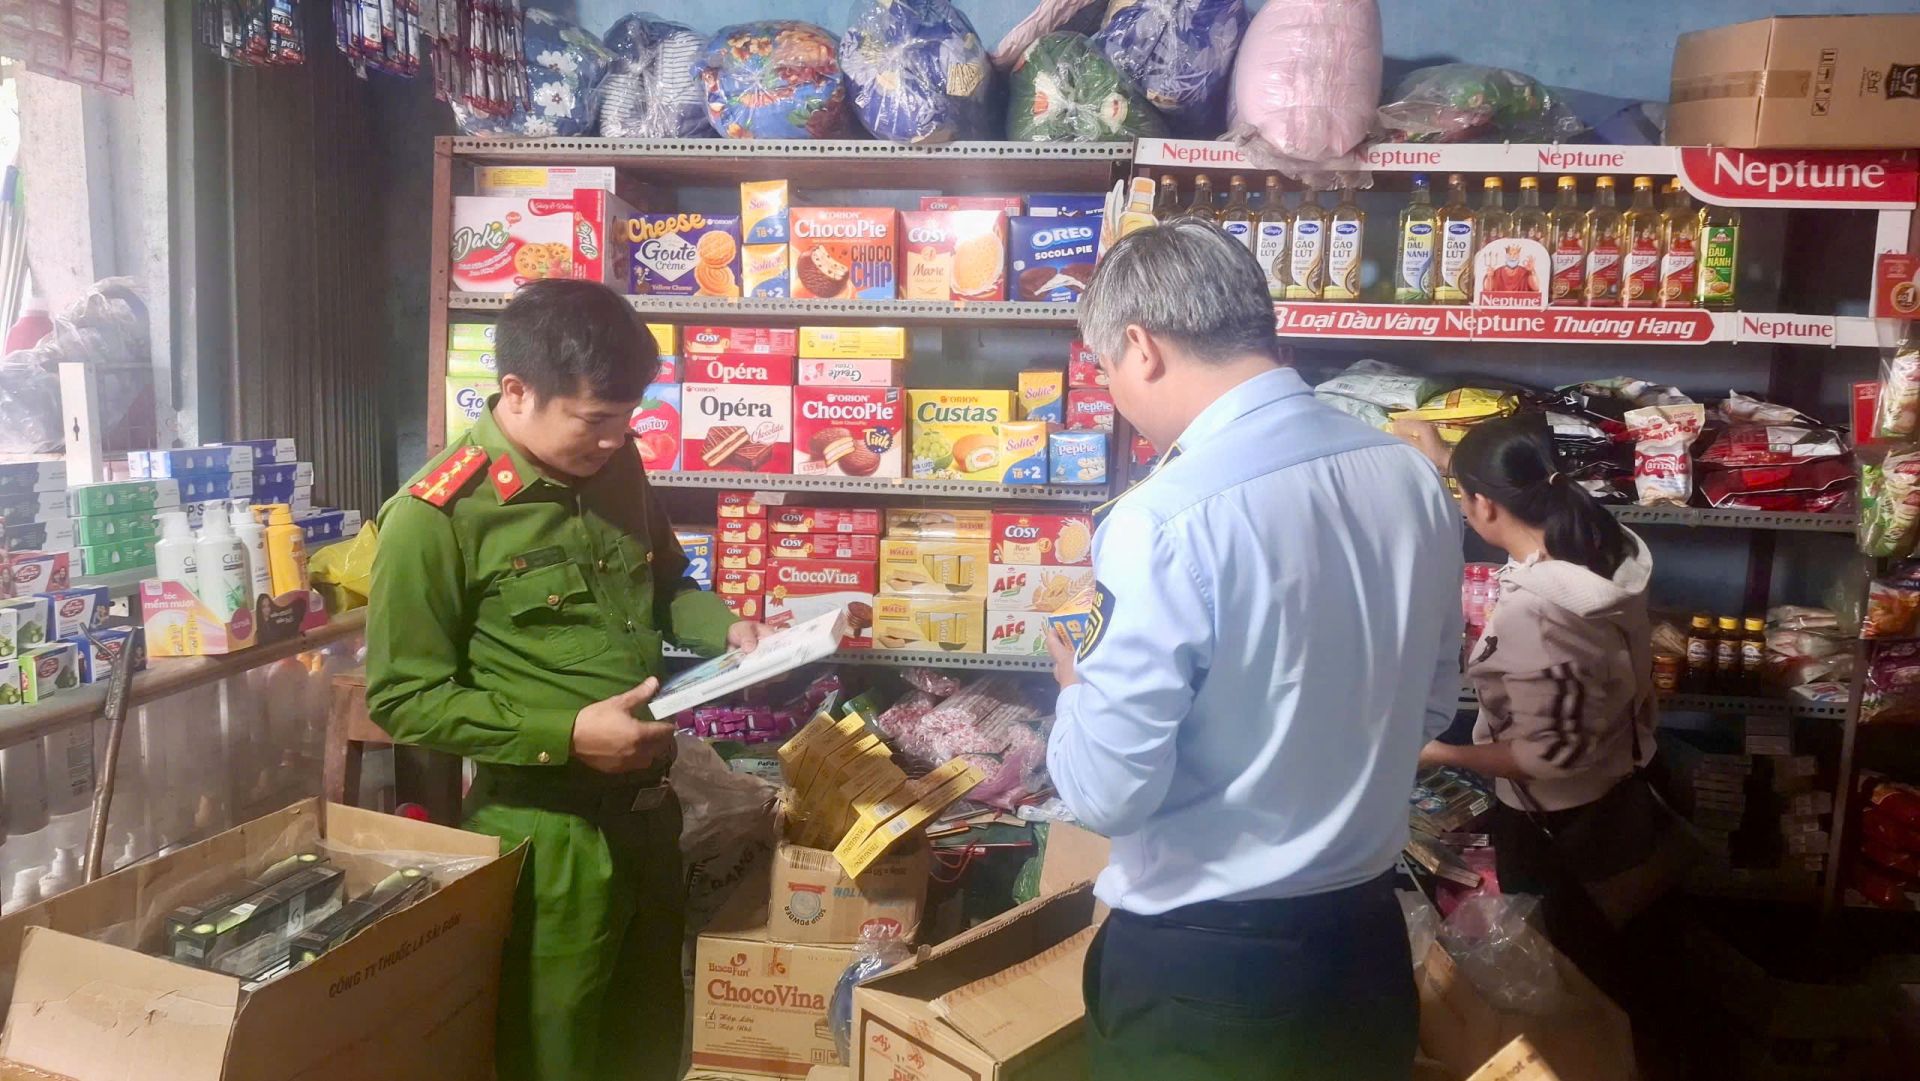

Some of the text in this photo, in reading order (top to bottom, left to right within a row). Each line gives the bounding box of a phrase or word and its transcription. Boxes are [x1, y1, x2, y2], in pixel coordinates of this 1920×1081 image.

[1162, 142, 1246, 163] Neptune
[1538, 149, 1624, 169] Neptune
[1714, 152, 1885, 192] Neptune
[826, 211, 860, 219] ORION
[628, 213, 706, 242] Cheese
[794, 219, 888, 238] ChocoPie
[908, 227, 947, 243] COSY
[1032, 227, 1093, 247] OREO
[642, 240, 696, 262] Gouté
[851, 245, 892, 262] CHOCO
[1035, 245, 1093, 260] SOCOLA PIE
[655, 261, 686, 271] Crème
[851, 261, 892, 288] CHIP
[1481, 295, 1540, 305] Neptune
[1287, 309, 1335, 332] Loại
[1337, 309, 1381, 330] Dầu
[1384, 311, 1439, 337] Vàng
[1445, 310, 1545, 338] Neptune
[1553, 315, 1637, 338] Thượng
[1637, 317, 1697, 339] Hạng
[1742, 316, 1833, 339] Neptune
[695, 333, 721, 344] COSY
[1080, 352, 1100, 366] Pep
[707, 359, 768, 383] Opéra
[1025, 387, 1051, 399] Solite
[700, 396, 772, 421] Opéra
[803, 400, 893, 420] ChocoPie
[917, 402, 998, 422] Custas
[1077, 401, 1112, 413] PepPie
[1006, 436, 1035, 452] Solite
[1058, 443, 1098, 455] PepPie
[1012, 466, 1041, 479] 18+2
[726, 522, 742, 530] COSY
[781, 513, 804, 522] COSY
[1005, 525, 1040, 538] COSY
[726, 547, 742, 555] COSY
[780, 538, 803, 548] COSY
[690, 557, 708, 579] 2
[778, 566, 858, 585] ChocoVina
[992, 572, 1027, 593] AFC
[991, 620, 1025, 641] AFC
[784, 905, 827, 926] SOUP POWDER
[707, 978, 826, 1010] ChocoVina
